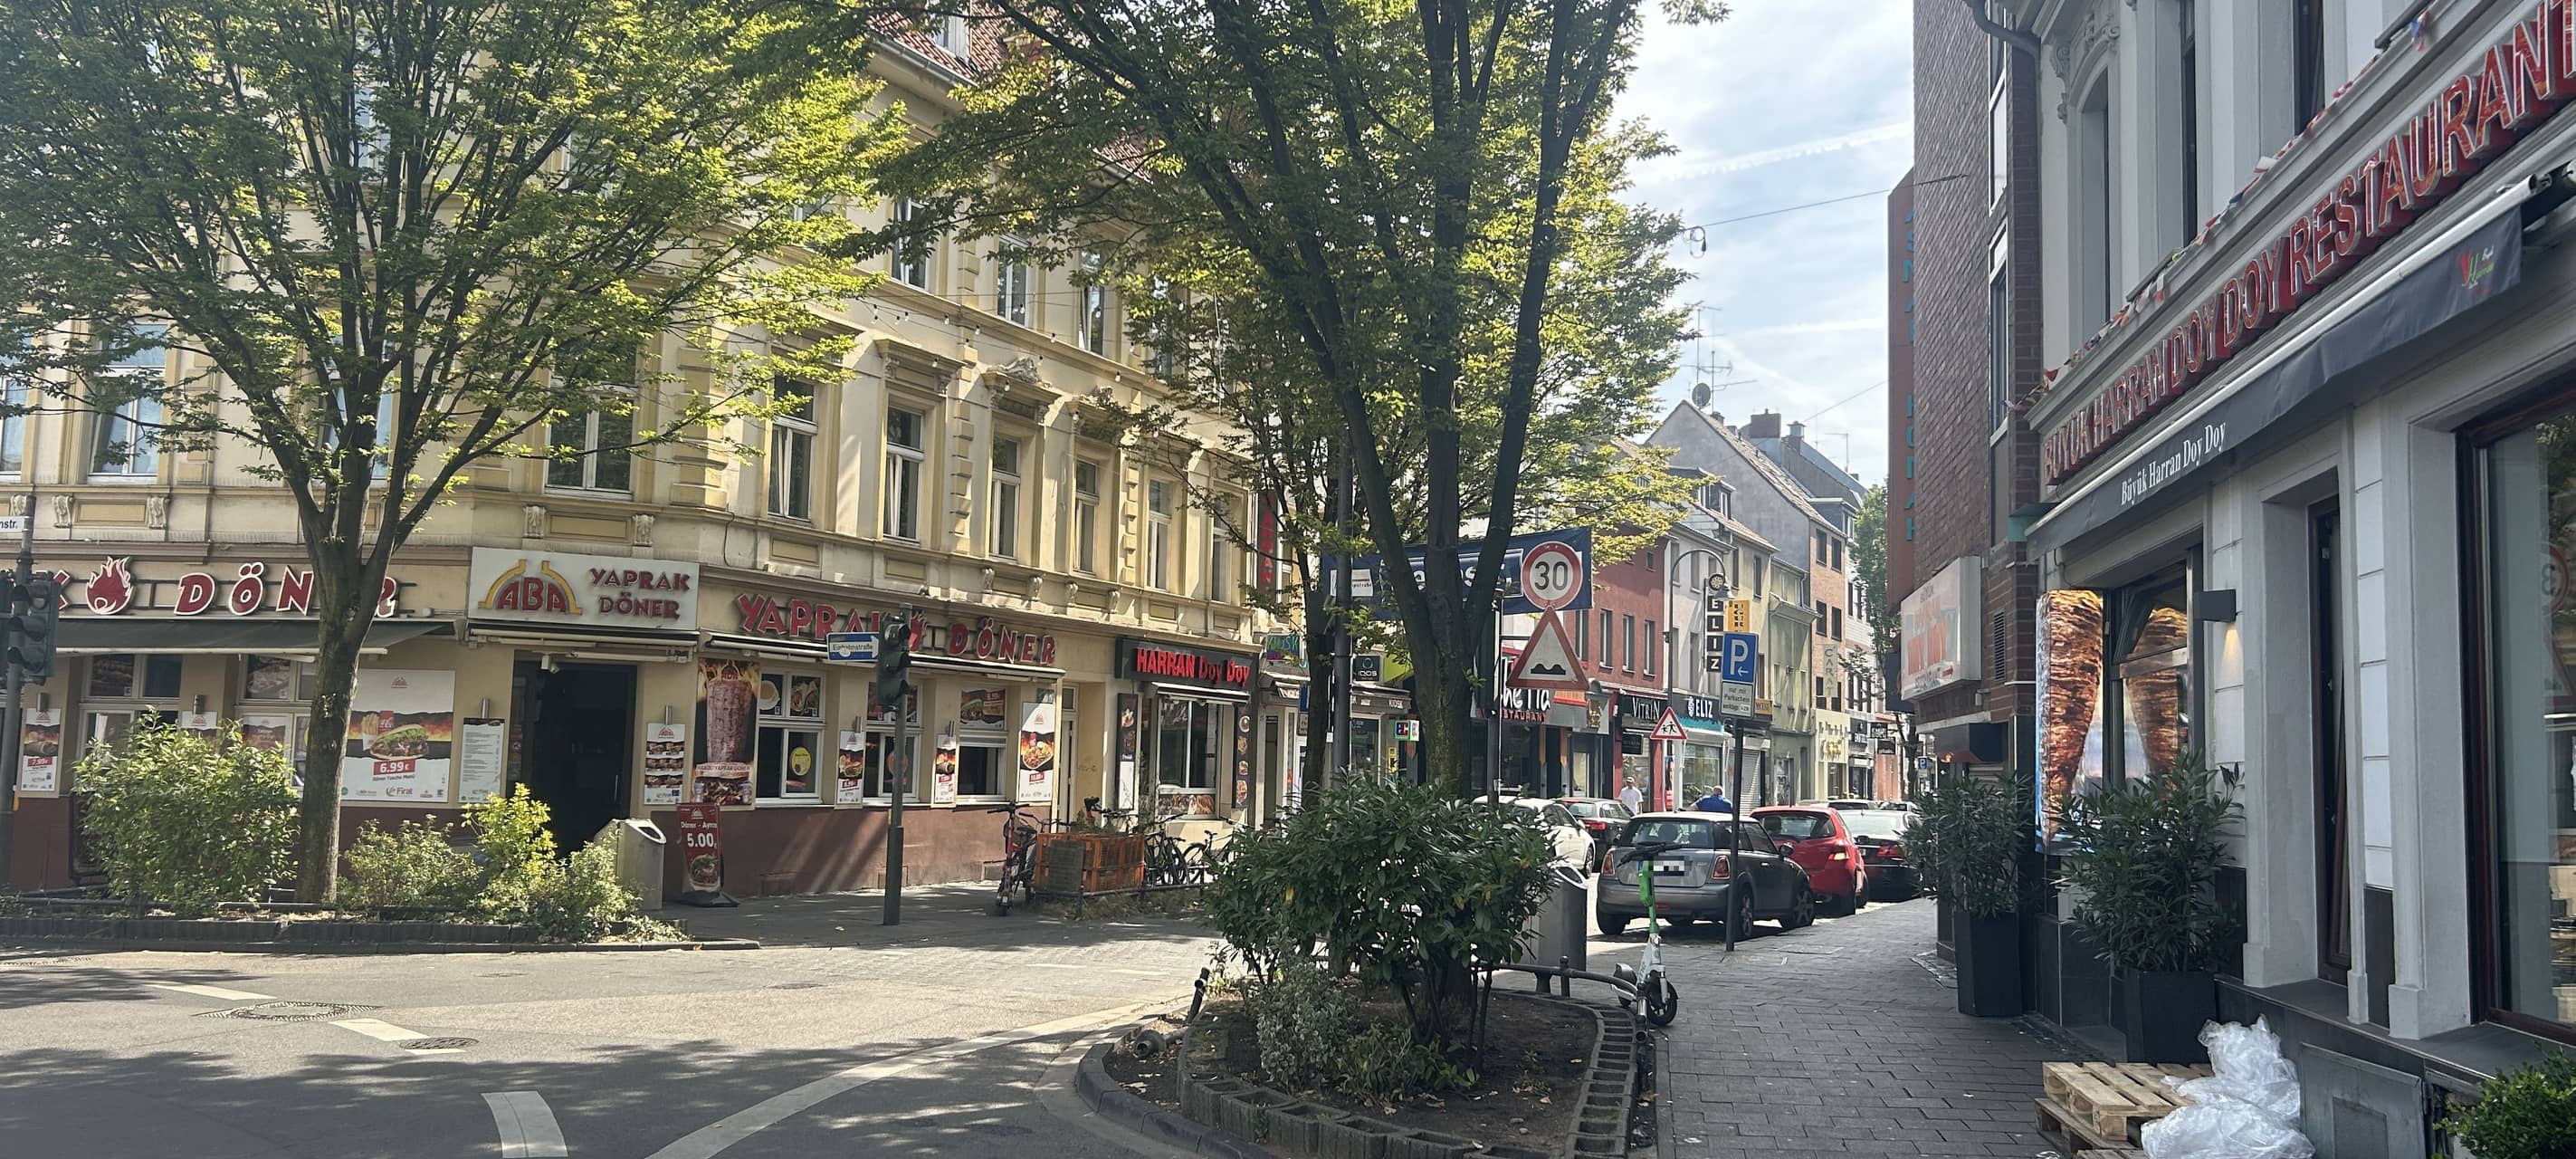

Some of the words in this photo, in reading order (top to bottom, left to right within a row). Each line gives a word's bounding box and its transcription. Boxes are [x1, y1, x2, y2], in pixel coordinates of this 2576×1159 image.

[2045, 407, 2093, 485] BÜYÜK
[2093, 339, 2169, 449] HARRAN
[2172, 293, 2218, 389] DOY
[2224, 239, 2282, 348] DOY
[2289, 0, 2576, 296] RESTAURANT
[2121, 468, 2147, 506] Büyük
[2149, 460, 2181, 489] Harran
[2182, 439, 2203, 467] Doy
[2205, 422, 2227, 455] Doy
[174, 561, 396, 618] DÖNR
[589, 567, 691, 591] YAPRAK
[1534, 560, 1569, 591] 30
[497, 576, 568, 614] ABA
[599, 590, 681, 619] DÖNER
[948, 616, 1056, 665] DÖNER
[1711, 599, 1720, 669] ELIZ
[1136, 647, 1196, 679] HARRAN
[1198, 655, 1223, 684] Doy
[1226, 659, 1251, 686] Doy
[1730, 638, 1749, 675] P
[1388, 699, 1404, 710] KIOSK
[1696, 699, 1713, 719] ELIZ
